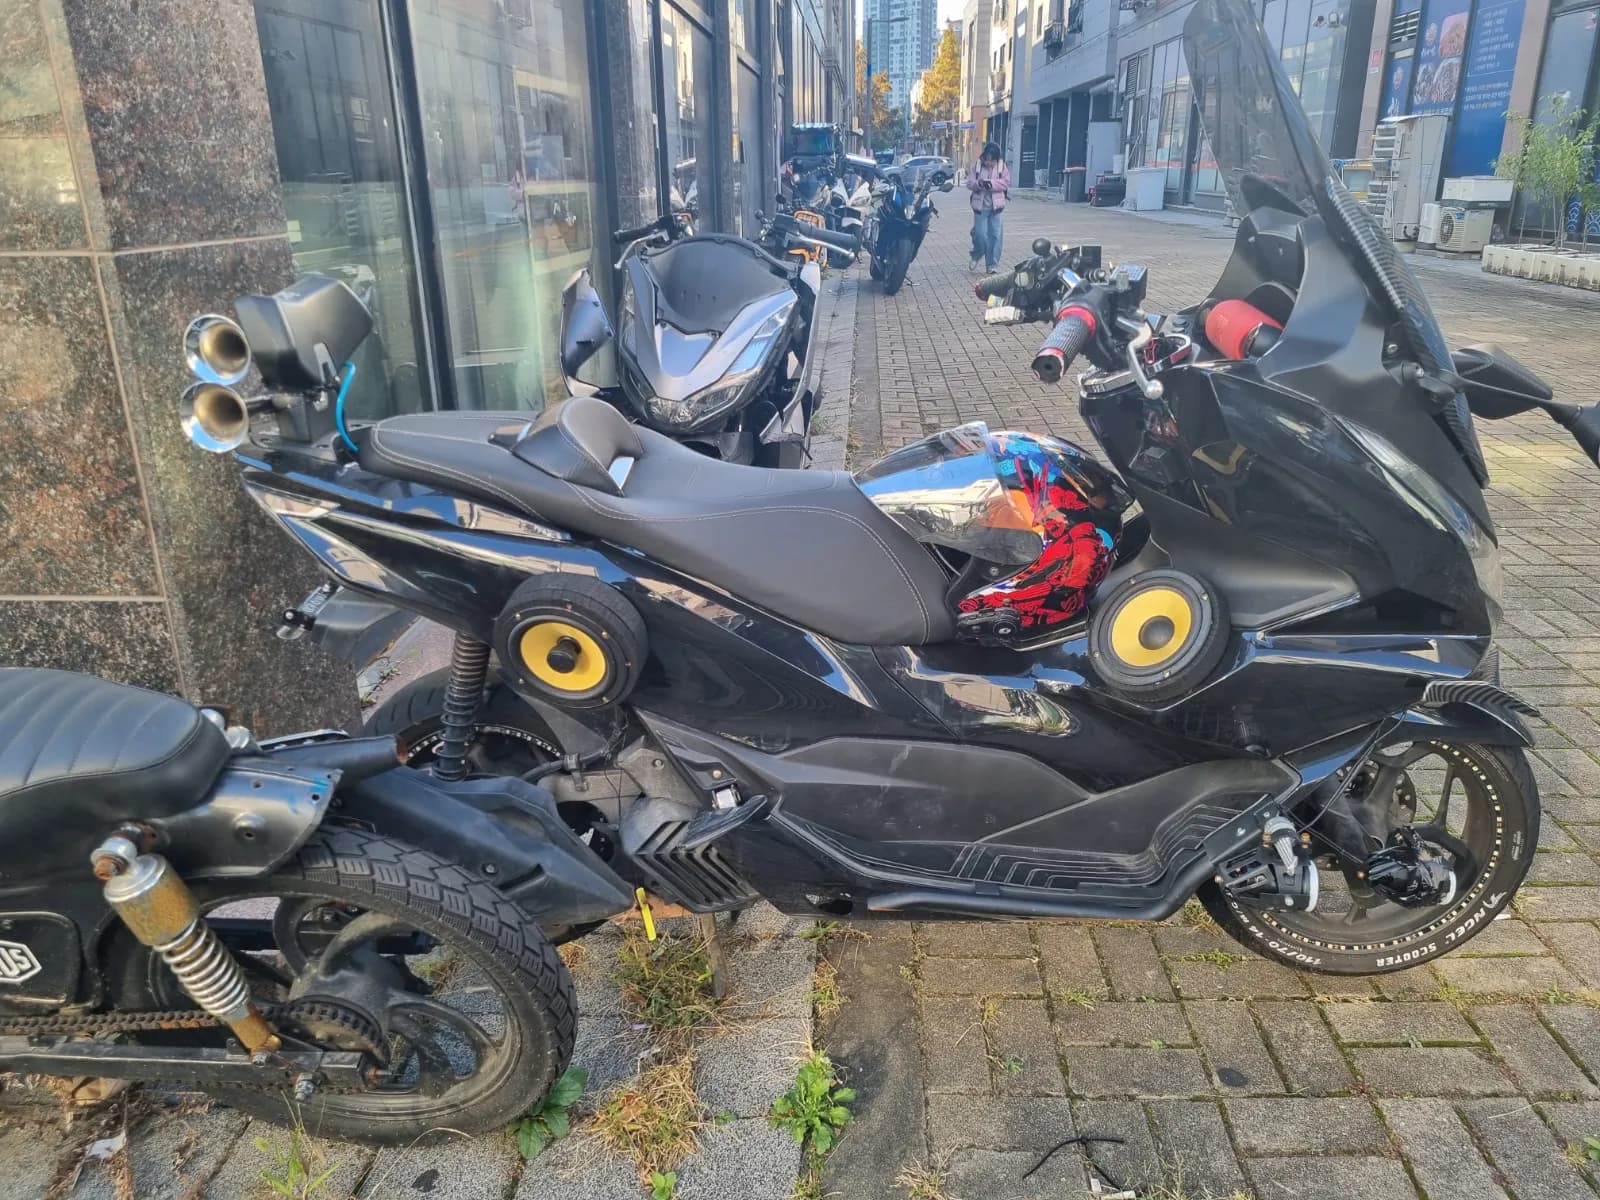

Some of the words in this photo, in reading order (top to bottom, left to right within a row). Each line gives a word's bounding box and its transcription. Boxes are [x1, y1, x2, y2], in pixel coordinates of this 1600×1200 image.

[1248, 925, 1322, 965] 110/70-14
[1376, 942, 1437, 967] SCOOTER
[0, 947, 32, 978] US
